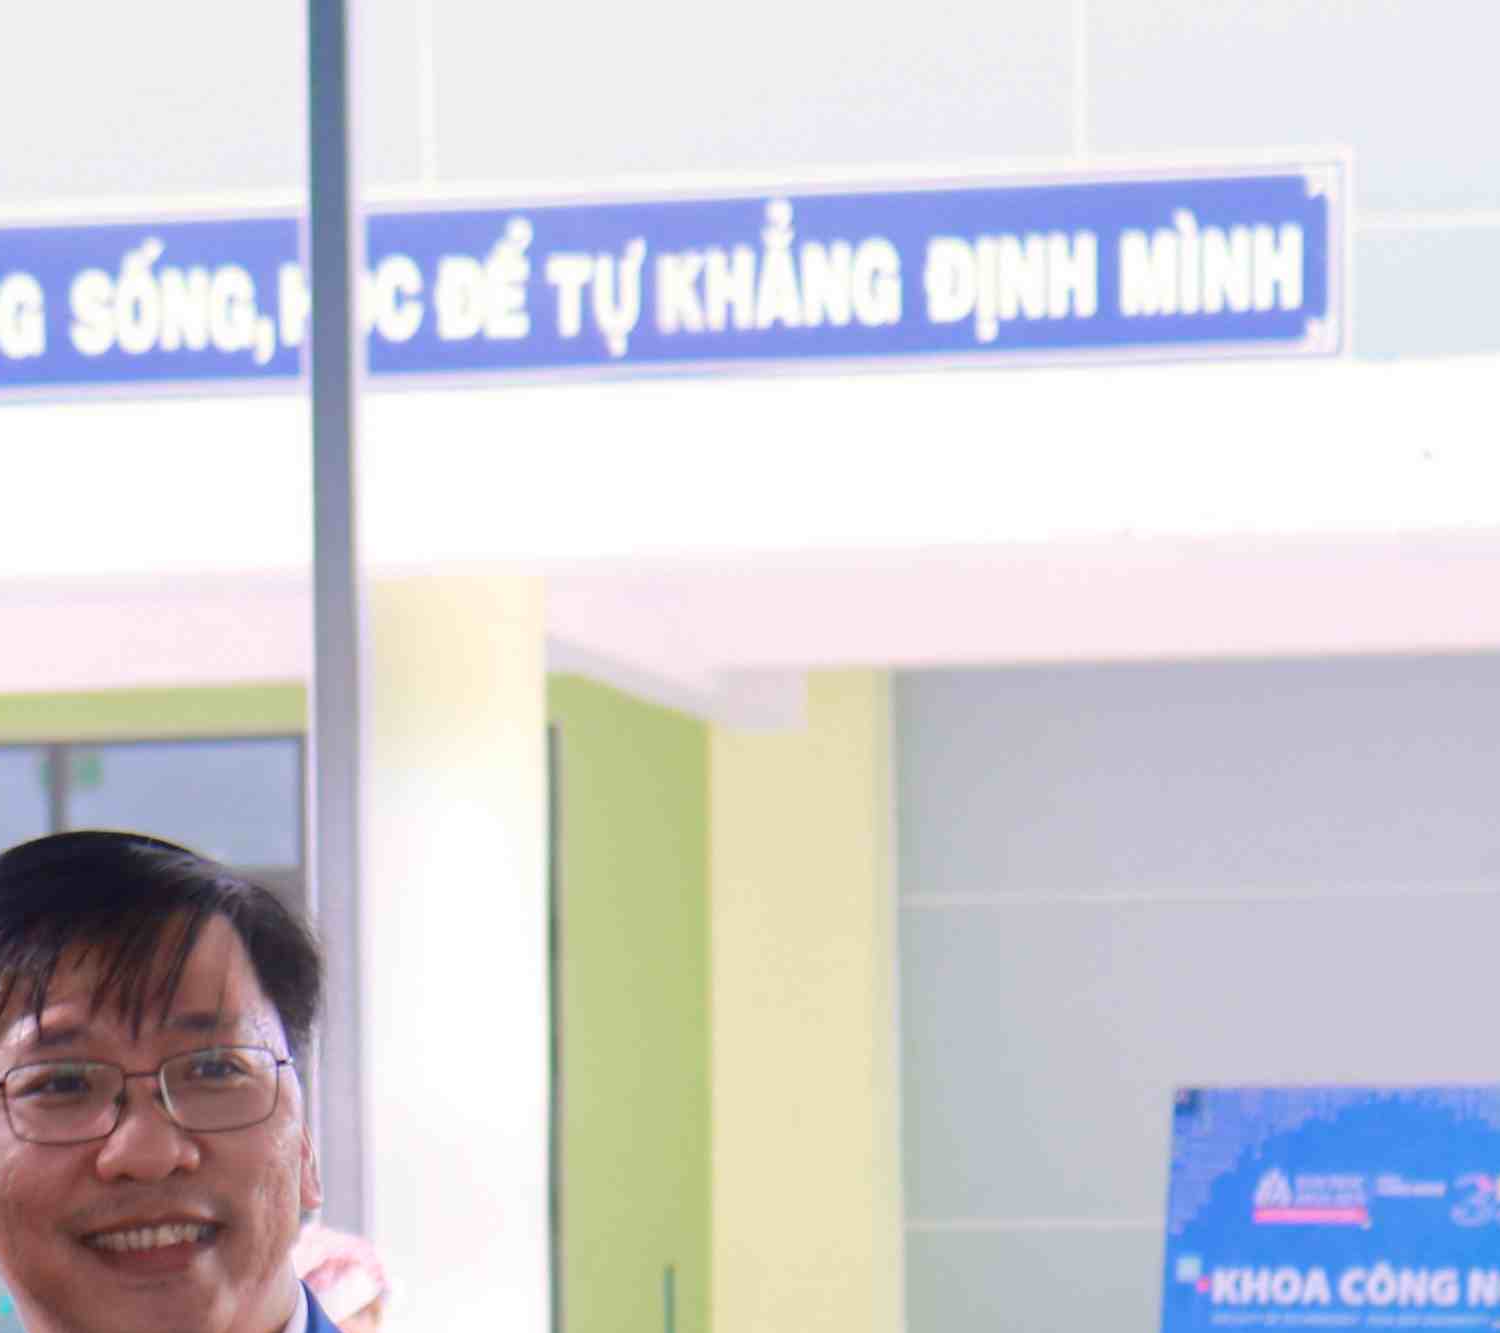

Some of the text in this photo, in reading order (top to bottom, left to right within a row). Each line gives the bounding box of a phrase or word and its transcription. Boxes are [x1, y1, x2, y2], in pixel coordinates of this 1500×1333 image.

[68, 240, 276, 364] SỐNG,
[438, 218, 532, 342] ĐỂ
[548, 238, 642, 354] TỰ
[658, 198, 902, 334] KHẲNG
[926, 232, 1098, 342] ĐỊNH
[1120, 210, 1304, 314] MÌNH
[1210, 1266, 1332, 1306] KHOA
[1339, 1258, 1458, 1308] CÔNG
